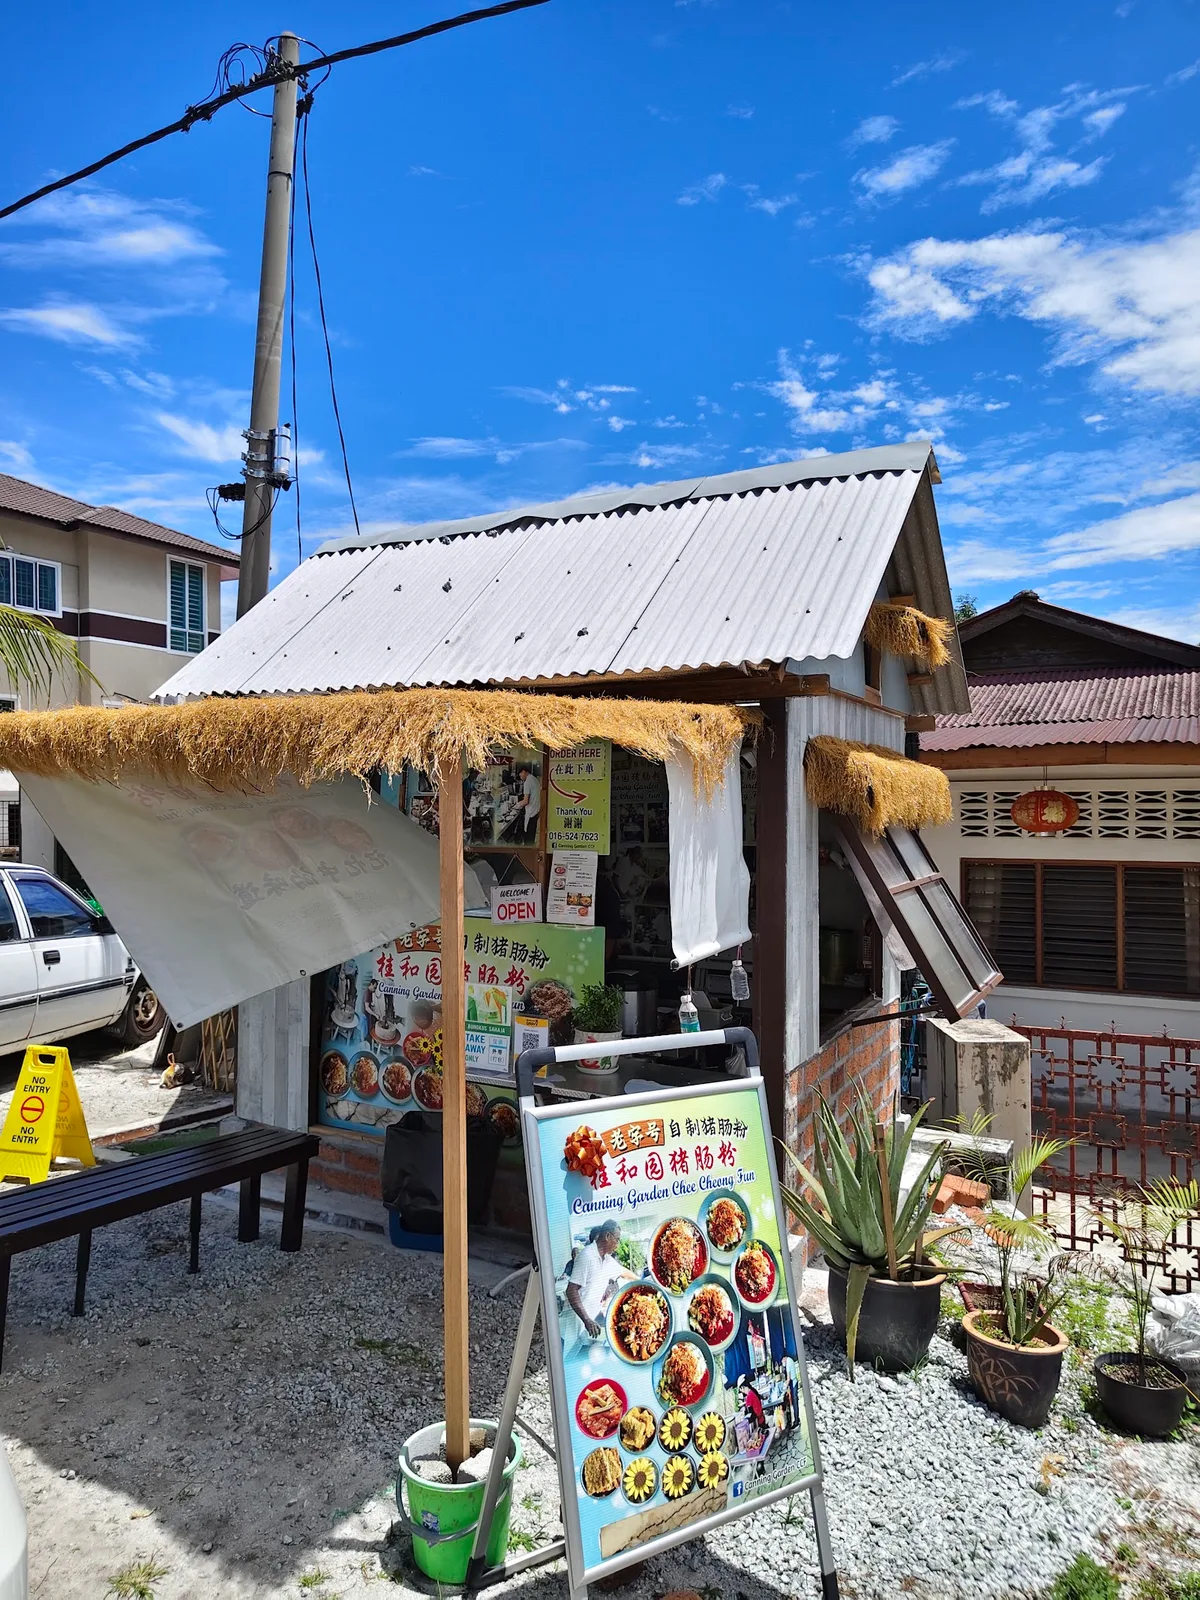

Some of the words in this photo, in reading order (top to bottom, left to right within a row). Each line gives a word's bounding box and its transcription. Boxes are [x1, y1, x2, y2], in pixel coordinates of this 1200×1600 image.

[549, 748, 577, 759] ORDER
[578, 748, 601, 758] HERE
[555, 763, 594, 775] 在此下单
[611, 784, 632, 793] nning
[556, 807, 577, 816] Thank
[579, 807, 593, 816] You
[549, 831, 579, 841] 016-524
[580, 832, 599, 841] 7623
[497, 901, 536, 921] OPEN
[463, 932, 550, 970] 制猪肠粉
[378, 983, 411, 998] Canning
[412, 984, 443, 1001] Garden
[467, 1023, 488, 1032] BUNGKUS
[488, 1025, 506, 1034] SAHAJA
[465, 1033, 486, 1044] TAKE
[465, 1044, 486, 1054] AWAY
[32, 1076, 46, 1085] NO
[23, 1084, 51, 1094] ENTRY
[20, 1126, 35, 1135] NO
[610, 1122, 662, 1152] 老字号
[668, 1116, 748, 1140] 自制猪肠粉
[11, 1134, 40, 1145] ENTRY
[590, 1140, 737, 1191] 桂和园猪肠粉
[572, 1195, 624, 1215] Canning
[627, 1187, 669, 1205] Garden
[671, 1180, 697, 1200] Chee
[699, 1172, 734, 1192] Cheong
[736, 1168, 755, 1184] Fun
[744, 1474, 771, 1491] Canning
[772, 1464, 795, 1480] Garden
[796, 1457, 807, 1469] CCF
